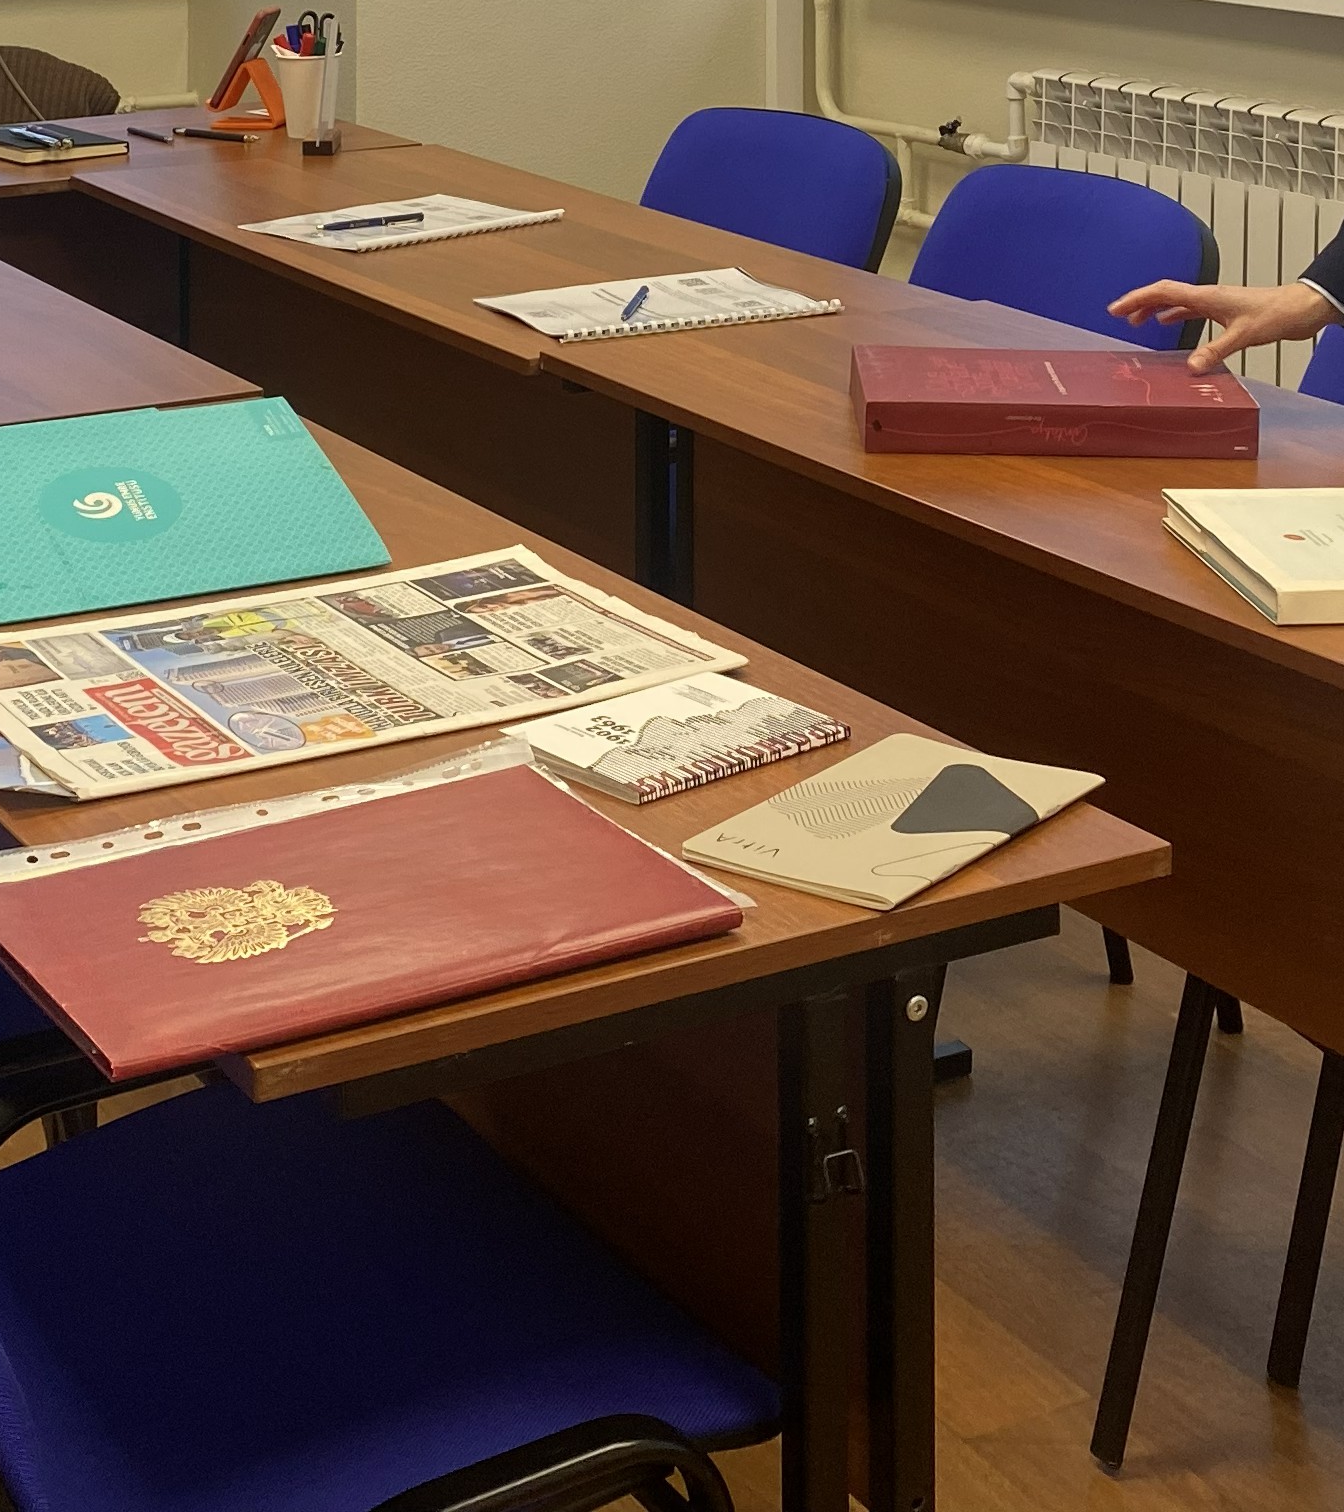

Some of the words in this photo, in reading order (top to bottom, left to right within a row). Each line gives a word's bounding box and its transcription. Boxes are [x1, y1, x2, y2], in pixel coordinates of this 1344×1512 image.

[102, 683, 242, 761] gazetem
[591, 715, 635, 734] 1963
[586, 725, 631, 744] 1902
